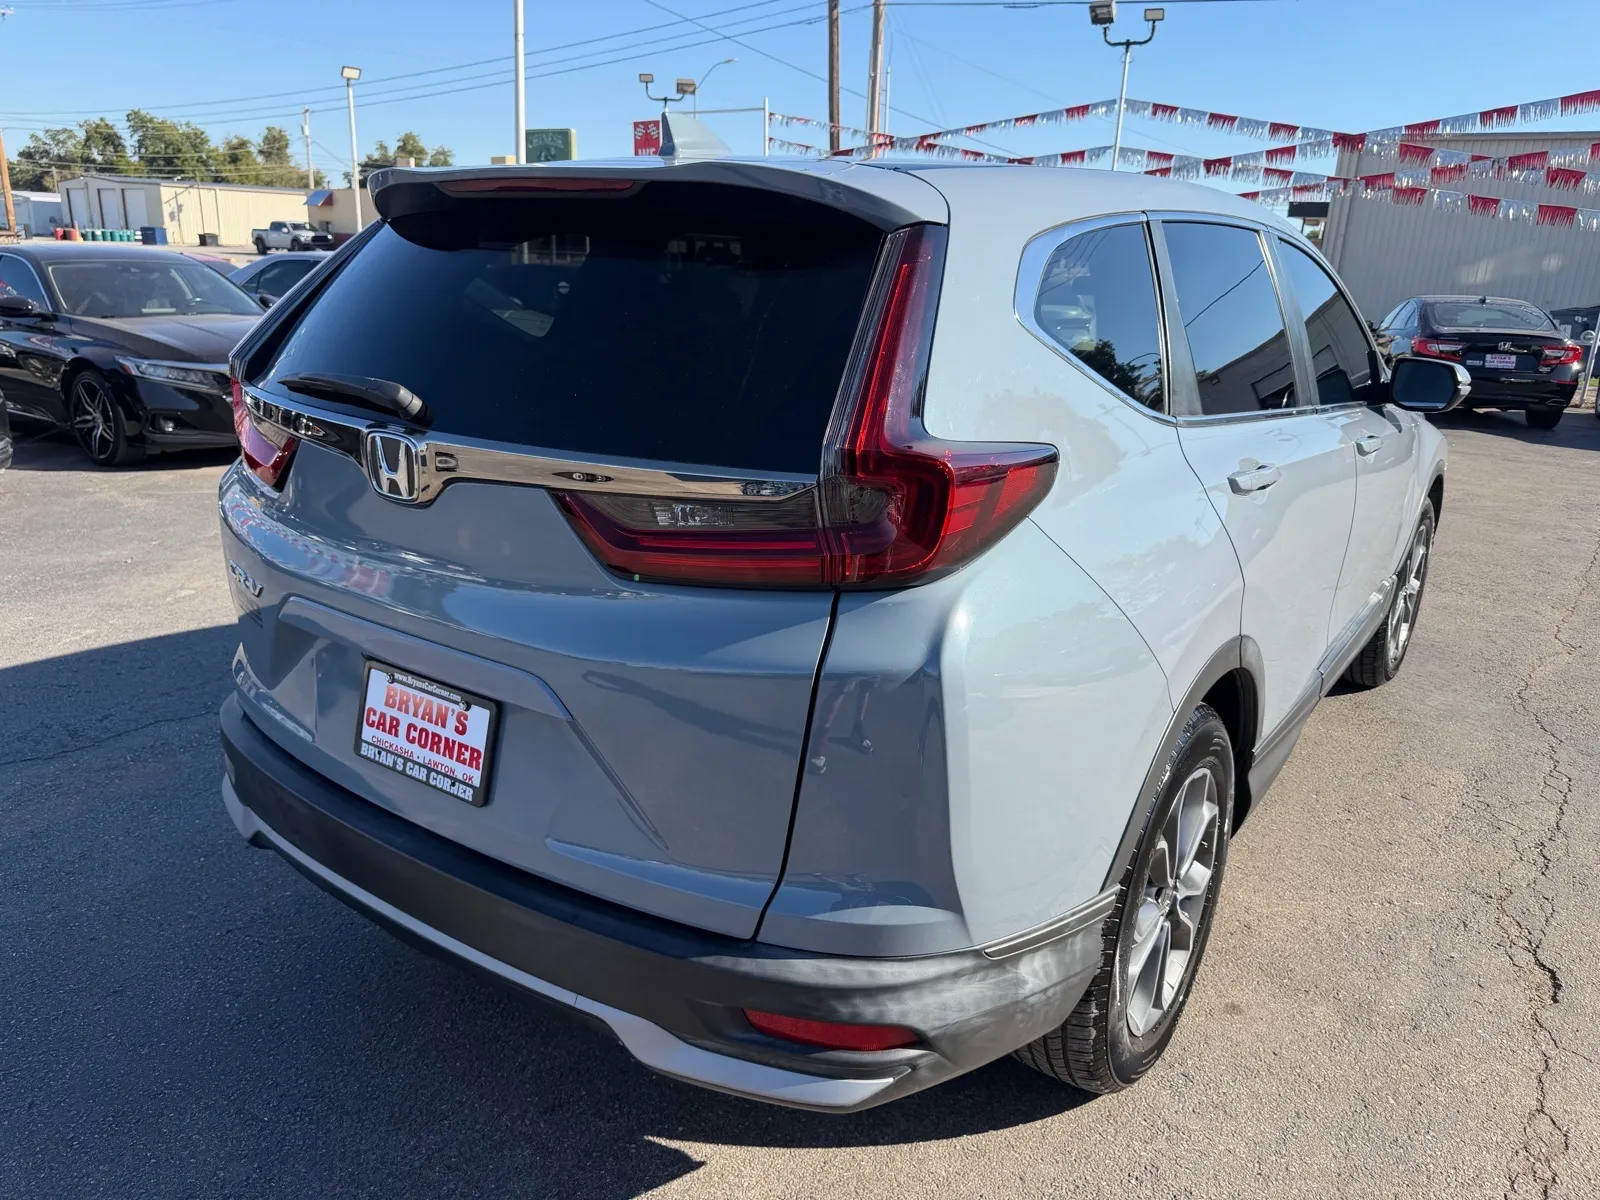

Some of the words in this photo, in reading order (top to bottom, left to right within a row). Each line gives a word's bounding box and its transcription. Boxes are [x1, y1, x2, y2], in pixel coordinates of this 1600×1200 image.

[384, 684, 469, 736] BRYAN'S
[365, 706, 400, 738] CAR
[405, 722, 482, 771] CORNER
[371, 735, 414, 759] CHICKASHA
[462, 772, 474, 784] OK
[360, 742, 404, 771] BRYAN'S
[405, 761, 428, 781] CAR
[429, 772, 474, 802] CORNER
